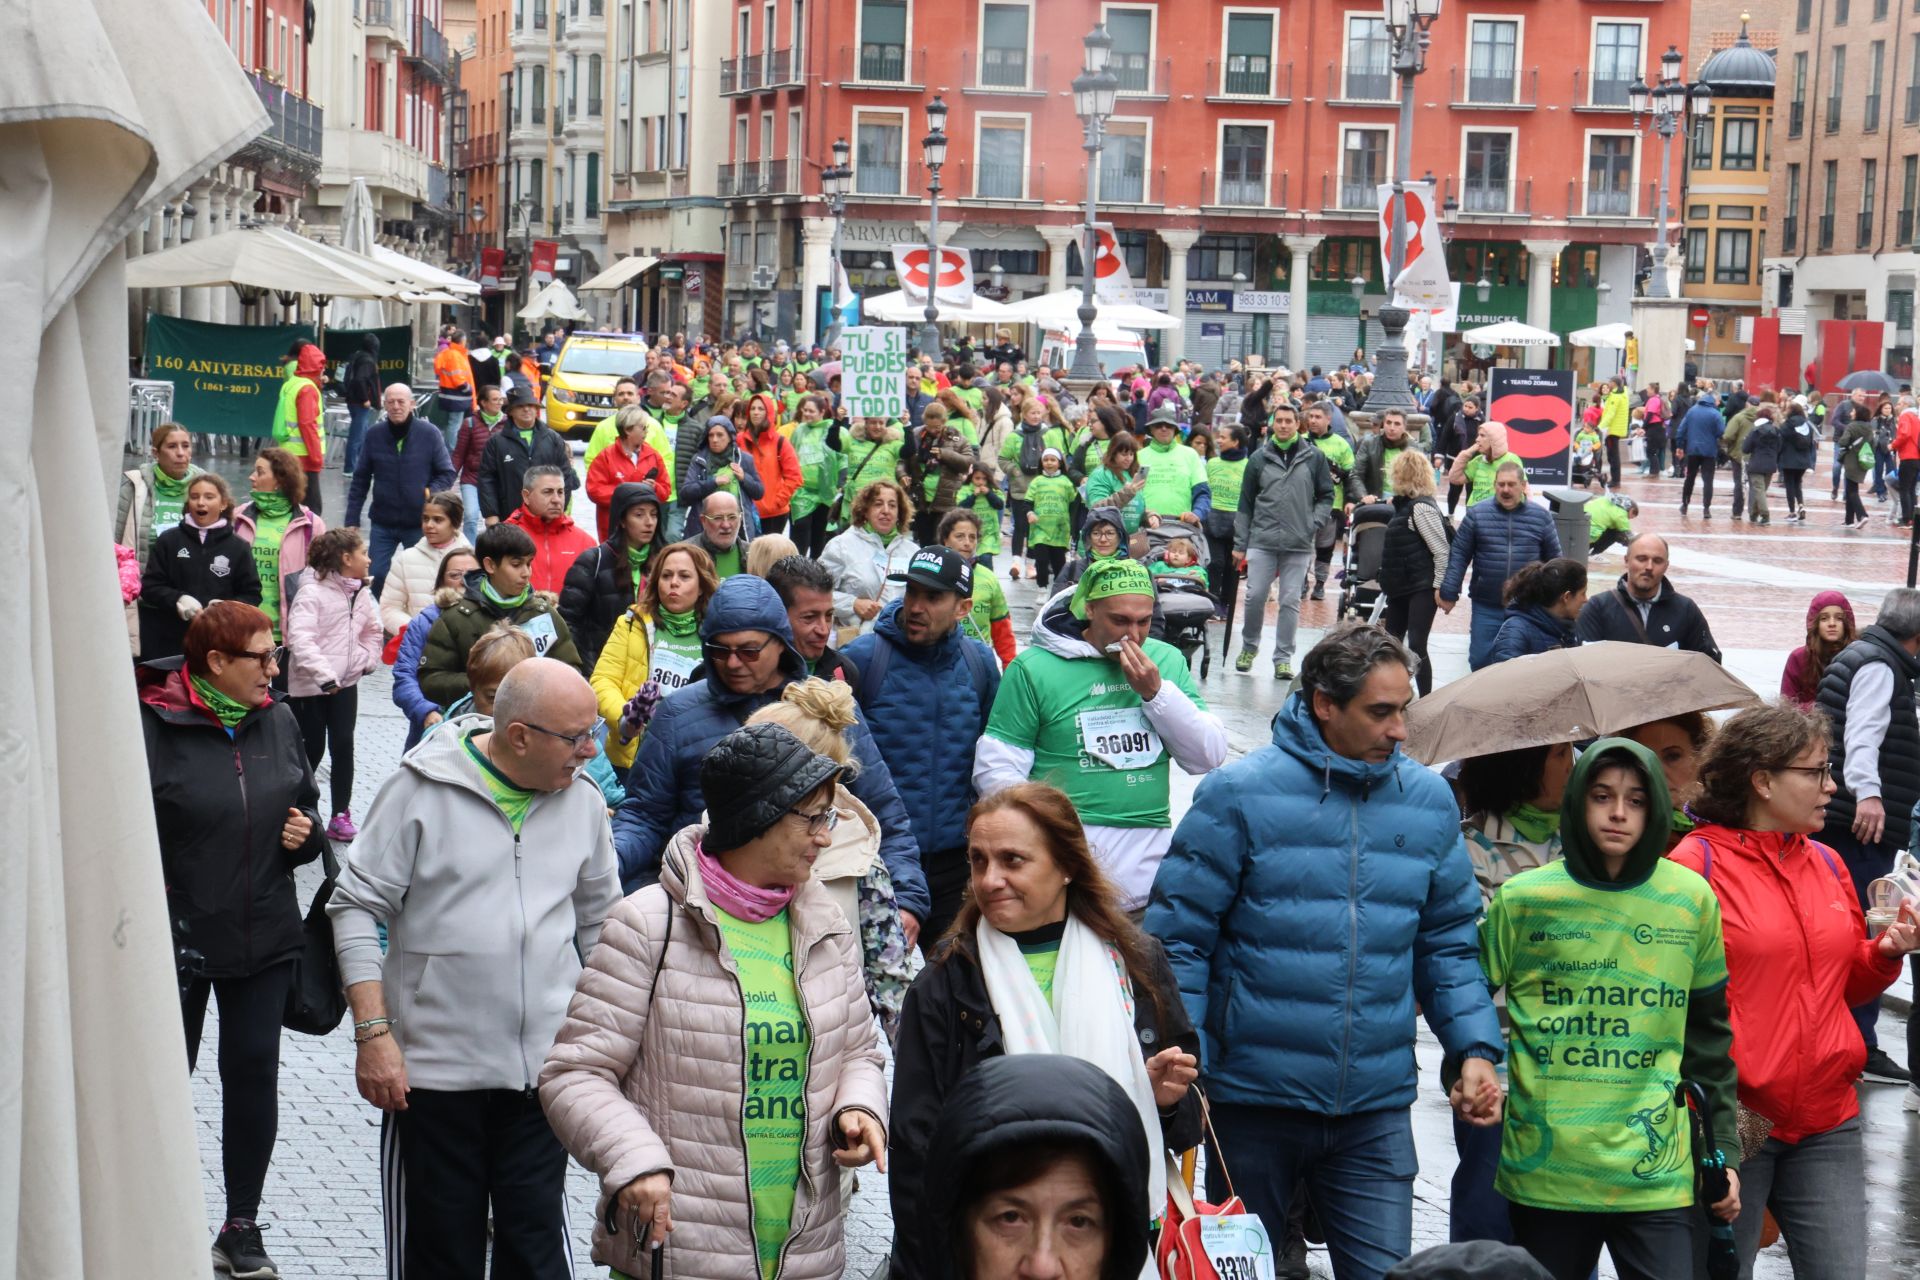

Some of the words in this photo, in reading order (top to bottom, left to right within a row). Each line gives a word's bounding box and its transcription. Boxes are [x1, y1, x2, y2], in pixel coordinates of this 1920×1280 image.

[1238, 293, 1255, 306] 983
[1257, 294, 1268, 306] 33
[1270, 294, 1282, 306] 10
[884, 331, 901, 352] SI
[1501, 337, 1554, 345] STARBUCKS
[155, 355, 183, 370] 160
[842, 352, 906, 373] PUEDES
[855, 375, 898, 395] CON
[845, 396, 901, 417] TODO
[914, 552, 943, 566] BORA
[1103, 567, 1144, 580] contra
[1101, 582, 1114, 592] el
[1096, 732, 1151, 754] 36091
[1559, 958, 1618, 972] Valladolid
[1542, 980, 1573, 1007] En
[1578, 982, 1687, 1009] marcha
[1536, 1011, 1630, 1038] contra
[1536, 1040, 1554, 1065] el
[1563, 1041, 1663, 1070] cáncer
[750, 1052, 798, 1082] tra
